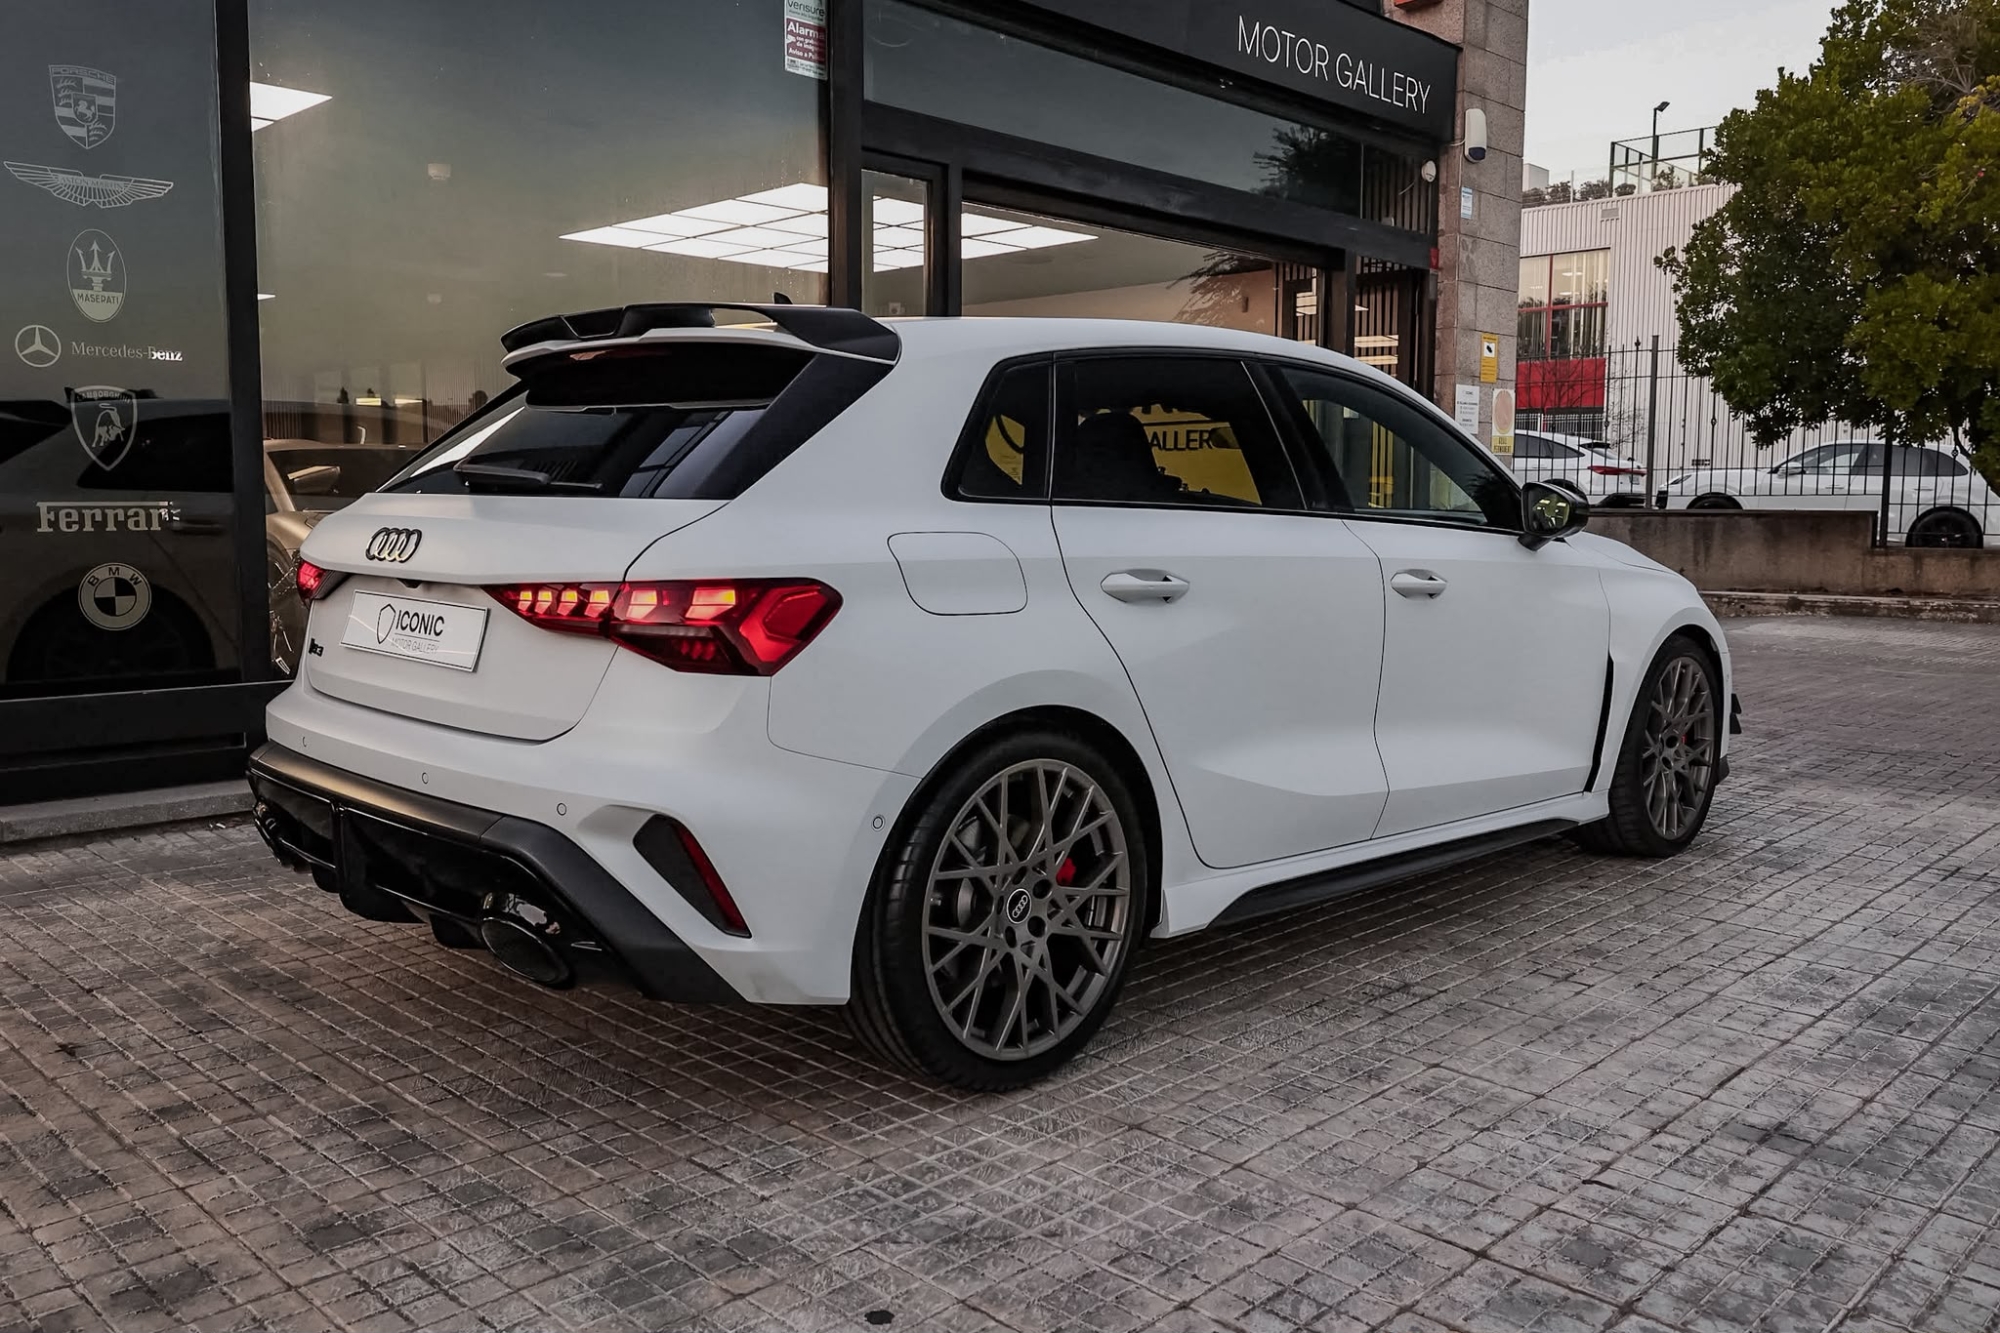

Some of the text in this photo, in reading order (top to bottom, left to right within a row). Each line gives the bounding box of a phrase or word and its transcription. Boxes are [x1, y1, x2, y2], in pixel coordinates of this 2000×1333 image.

[1238, 15, 1431, 114] MOTOR GALLERY
[52, 67, 115, 86] PORSCHE
[77, 293, 119, 305] MASERATI
[71, 341, 183, 361] Mercedes-Benz
[87, 567, 142, 587] BMW
[396, 609, 445, 637] ICONIC
